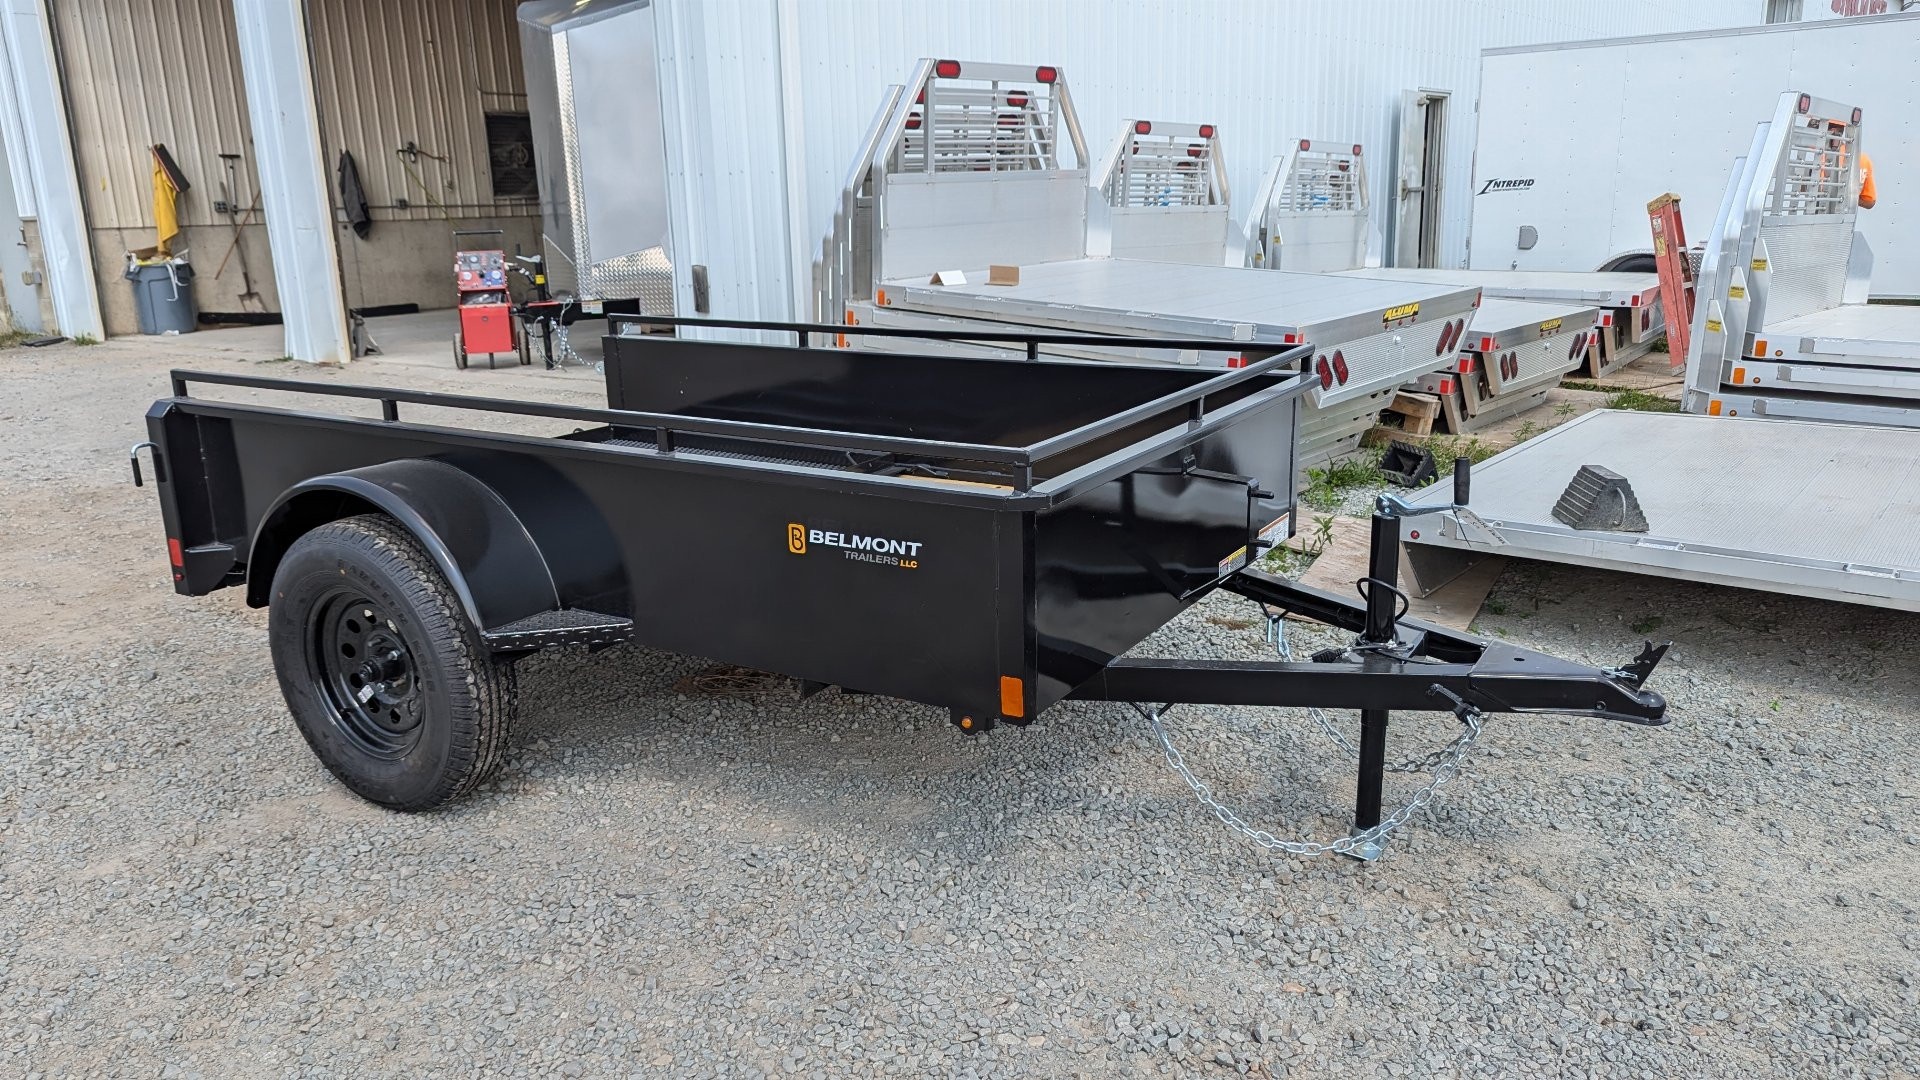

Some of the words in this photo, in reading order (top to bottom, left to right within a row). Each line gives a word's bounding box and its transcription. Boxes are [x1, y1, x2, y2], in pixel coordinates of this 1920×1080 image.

[1475, 178, 1535, 196] INTREPID
[1383, 302, 1419, 320] ALUMA
[809, 529, 923, 557] BELMONT
[843, 550, 899, 566] TRAILERS
[899, 559, 918, 568] LLC
